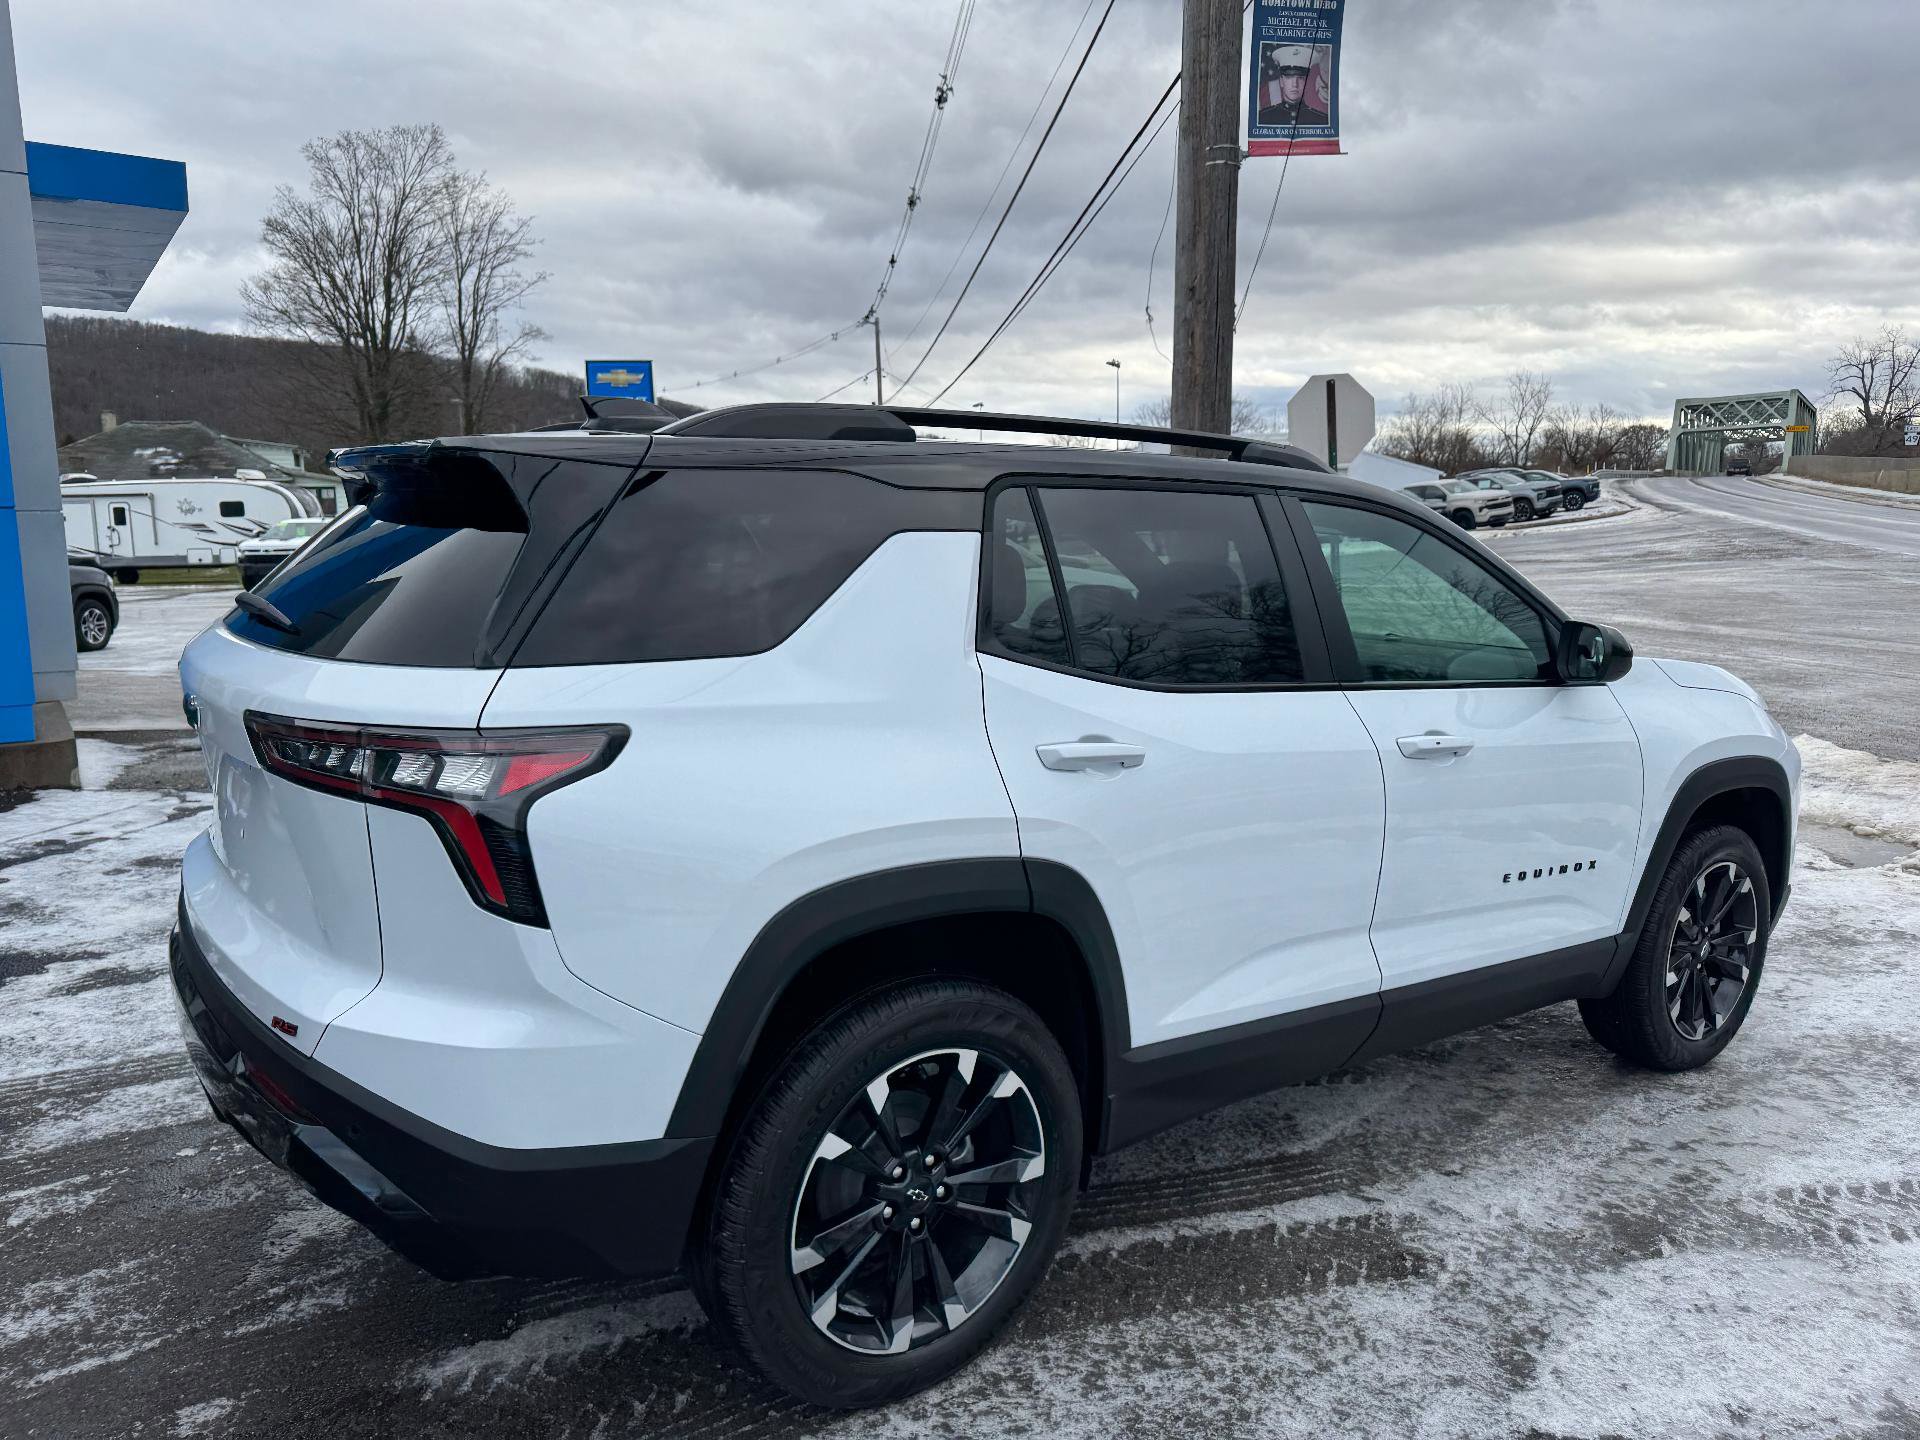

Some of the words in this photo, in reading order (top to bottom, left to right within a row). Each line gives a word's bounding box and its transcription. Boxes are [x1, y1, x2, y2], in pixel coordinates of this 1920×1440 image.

[1313, 0, 1337, 9] HERO
[1268, 17, 1301, 26] MICHAEL
[1277, 29, 1306, 37] MARINE
[1307, 30, 1332, 38] CORPS
[1502, 859, 1597, 883] EQUINOX
[271, 1015, 299, 1037] RS
